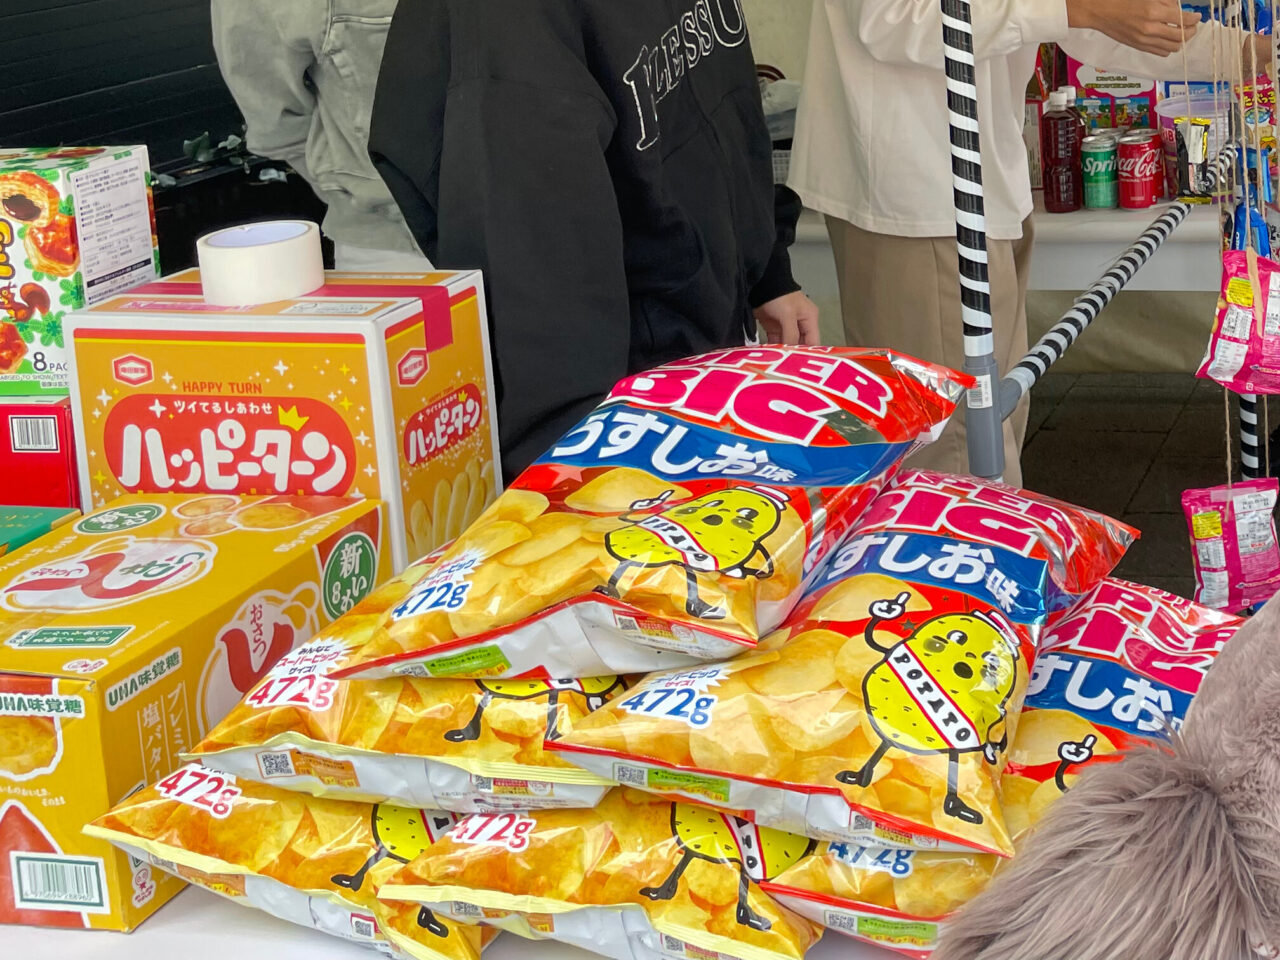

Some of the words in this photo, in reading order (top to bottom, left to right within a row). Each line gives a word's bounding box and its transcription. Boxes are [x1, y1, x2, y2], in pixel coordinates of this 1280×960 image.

[1083, 154, 1118, 177] Spri
[33, 351, 48, 372] 8
[173, 399, 273, 415] ツイてるしあわせ
[182, 381, 223, 393] HAPPY
[229, 382, 263, 394] TURN
[602, 367, 841, 447] BIG
[408, 398, 481, 465] ハッピーターン
[552, 403, 798, 483] うすしお味
[118, 418, 347, 493] ハッピーターン
[391, 582, 470, 618] 472g
[251, 603, 268, 658] おさつ
[107, 650, 181, 707] UHA味覚糖
[248, 674, 335, 708] 472g
[892, 651, 972, 743] POTATO
[620, 687, 715, 725] 472g
[159, 769, 240, 816] 472g
